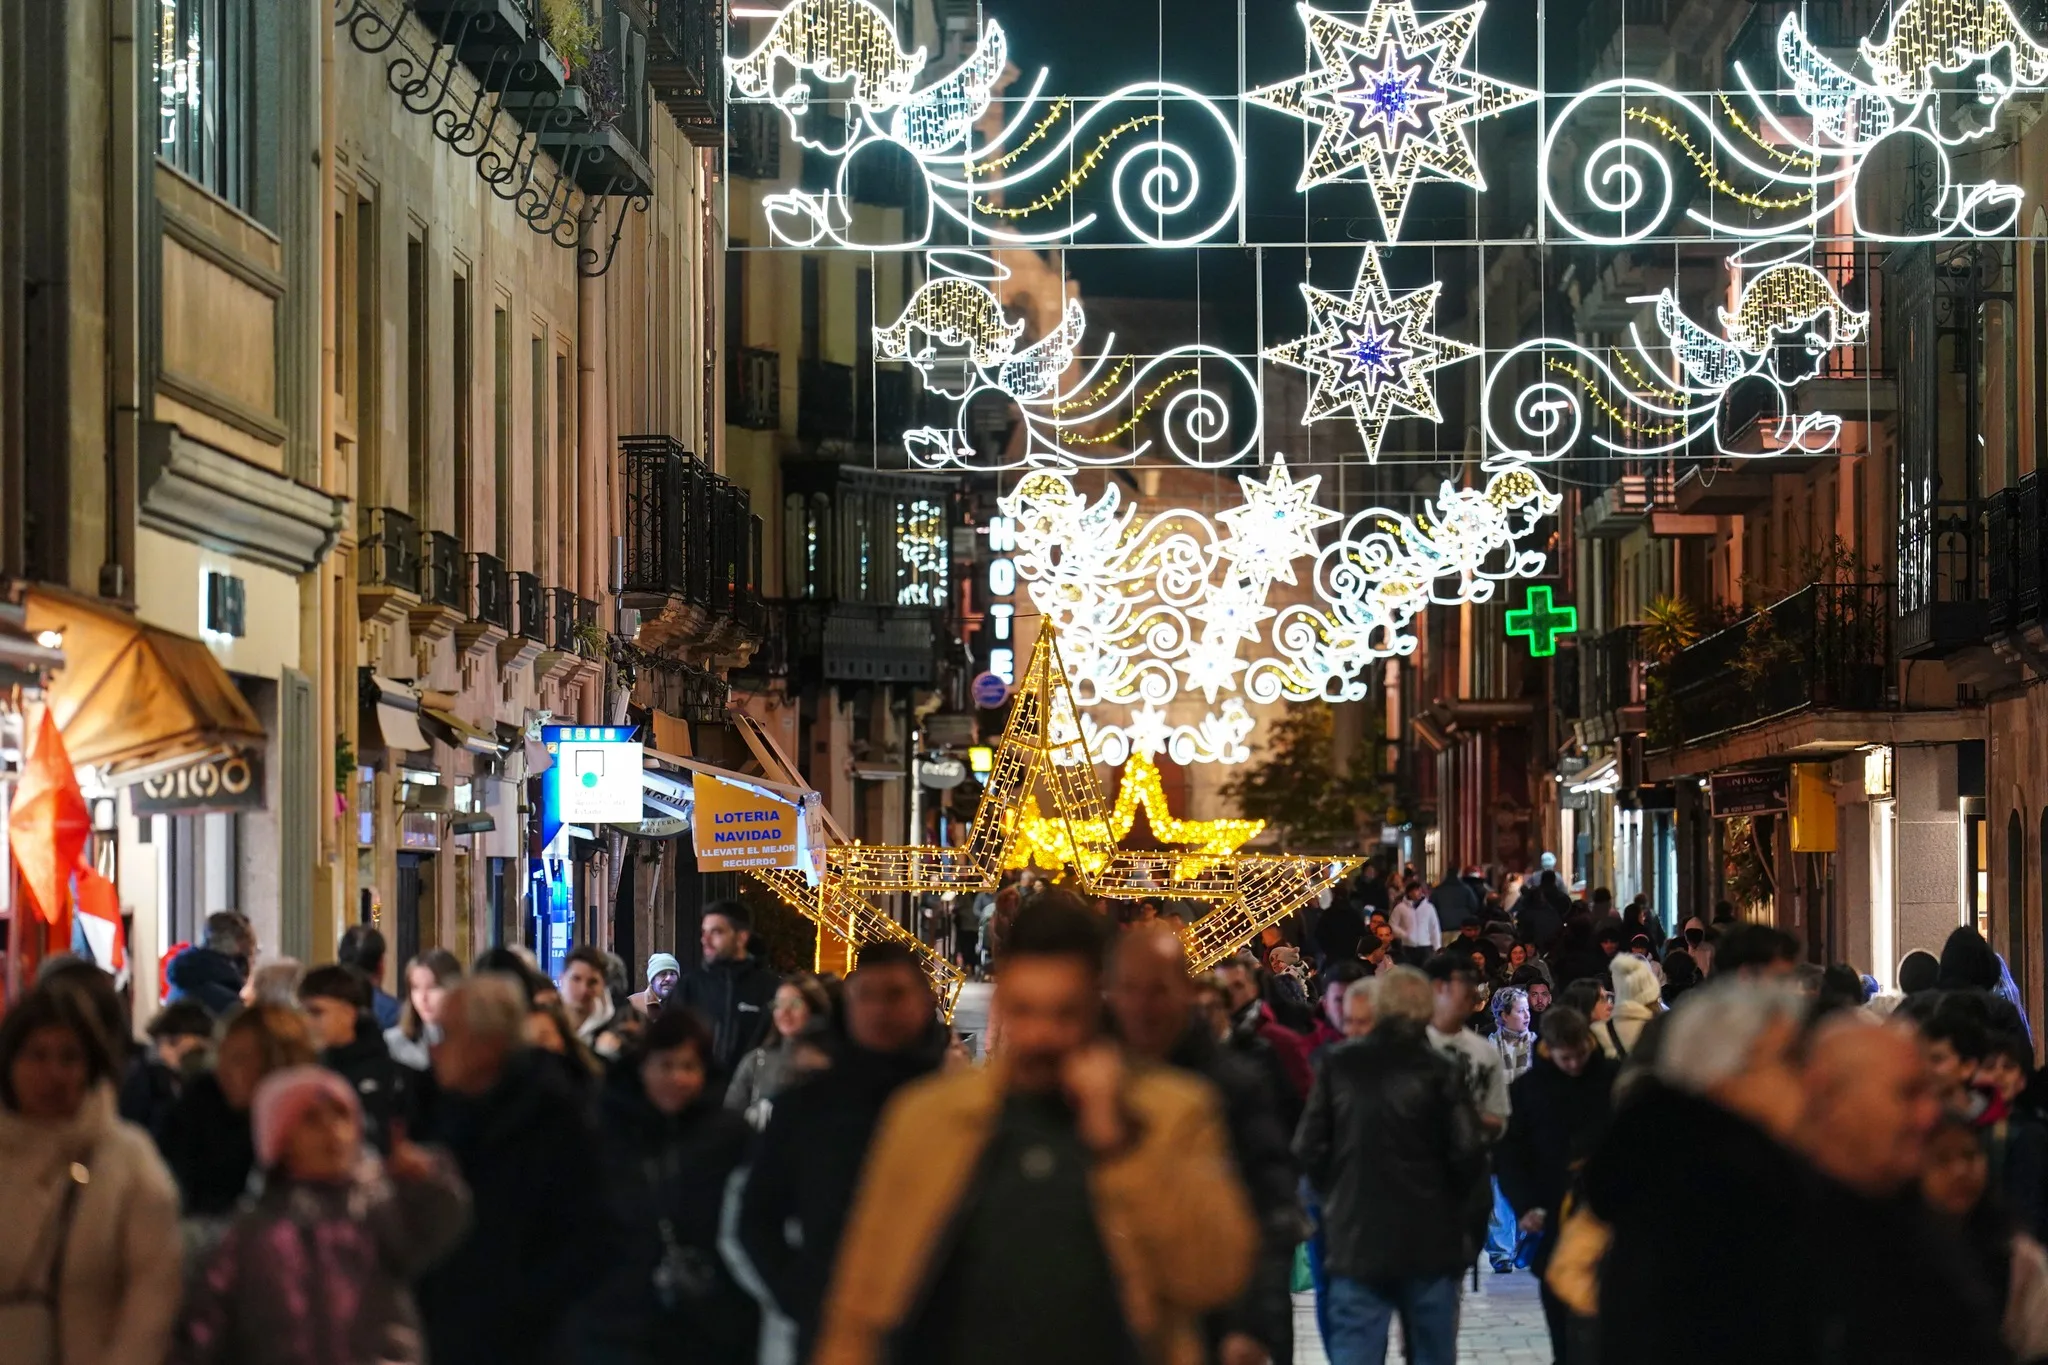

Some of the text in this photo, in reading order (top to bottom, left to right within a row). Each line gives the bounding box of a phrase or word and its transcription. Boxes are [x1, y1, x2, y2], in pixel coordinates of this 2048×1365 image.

[715, 810, 780, 824] LOTERIA
[715, 829, 781, 842] NAVIDAD
[702, 844, 796, 857] LLEVATE EL MEJOR
[722, 857, 777, 867] RECUERDO
